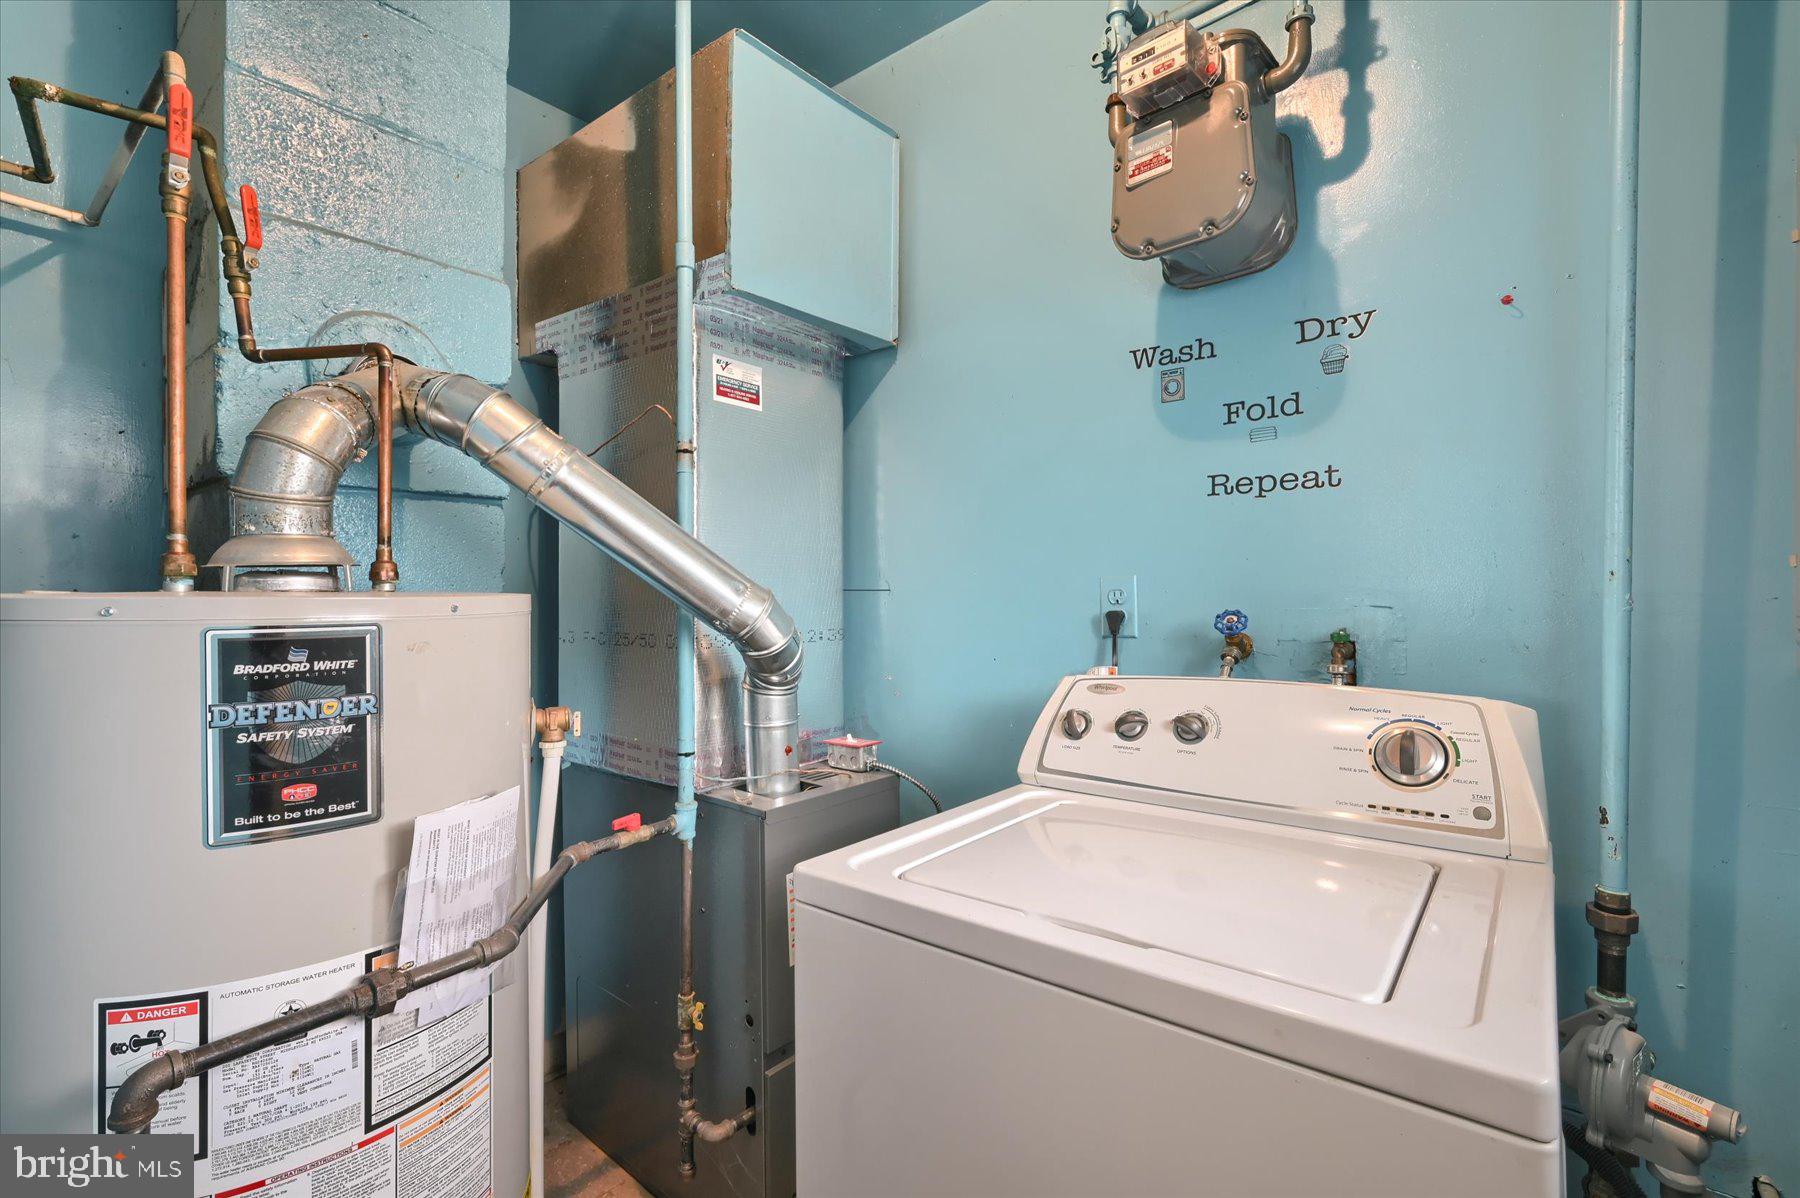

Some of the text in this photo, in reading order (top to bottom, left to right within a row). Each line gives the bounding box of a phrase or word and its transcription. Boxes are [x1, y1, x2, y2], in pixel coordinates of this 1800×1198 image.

[1295, 310, 1377, 344] Dry
[1129, 338, 1217, 370] Wash
[1222, 392, 1304, 426] Fold
[1206, 464, 1342, 498] Repeat
[233, 659, 356, 676] BRADFORD WHITE
[243, 670, 347, 680] CORPORATION
[208, 693, 378, 729] DEFENDER
[236, 723, 354, 744] SAFETY SYSTEM
[237, 762, 359, 782] ENERGY SAVER
[234, 801, 356, 826] Built to be the Best
[219, 962, 356, 1000] AUTOMATIC STORAGE WATER HEATER
[137, 1006, 188, 1020] DANGER
[271, 1148, 353, 1183] OPERATING INSTRUCTIONS
